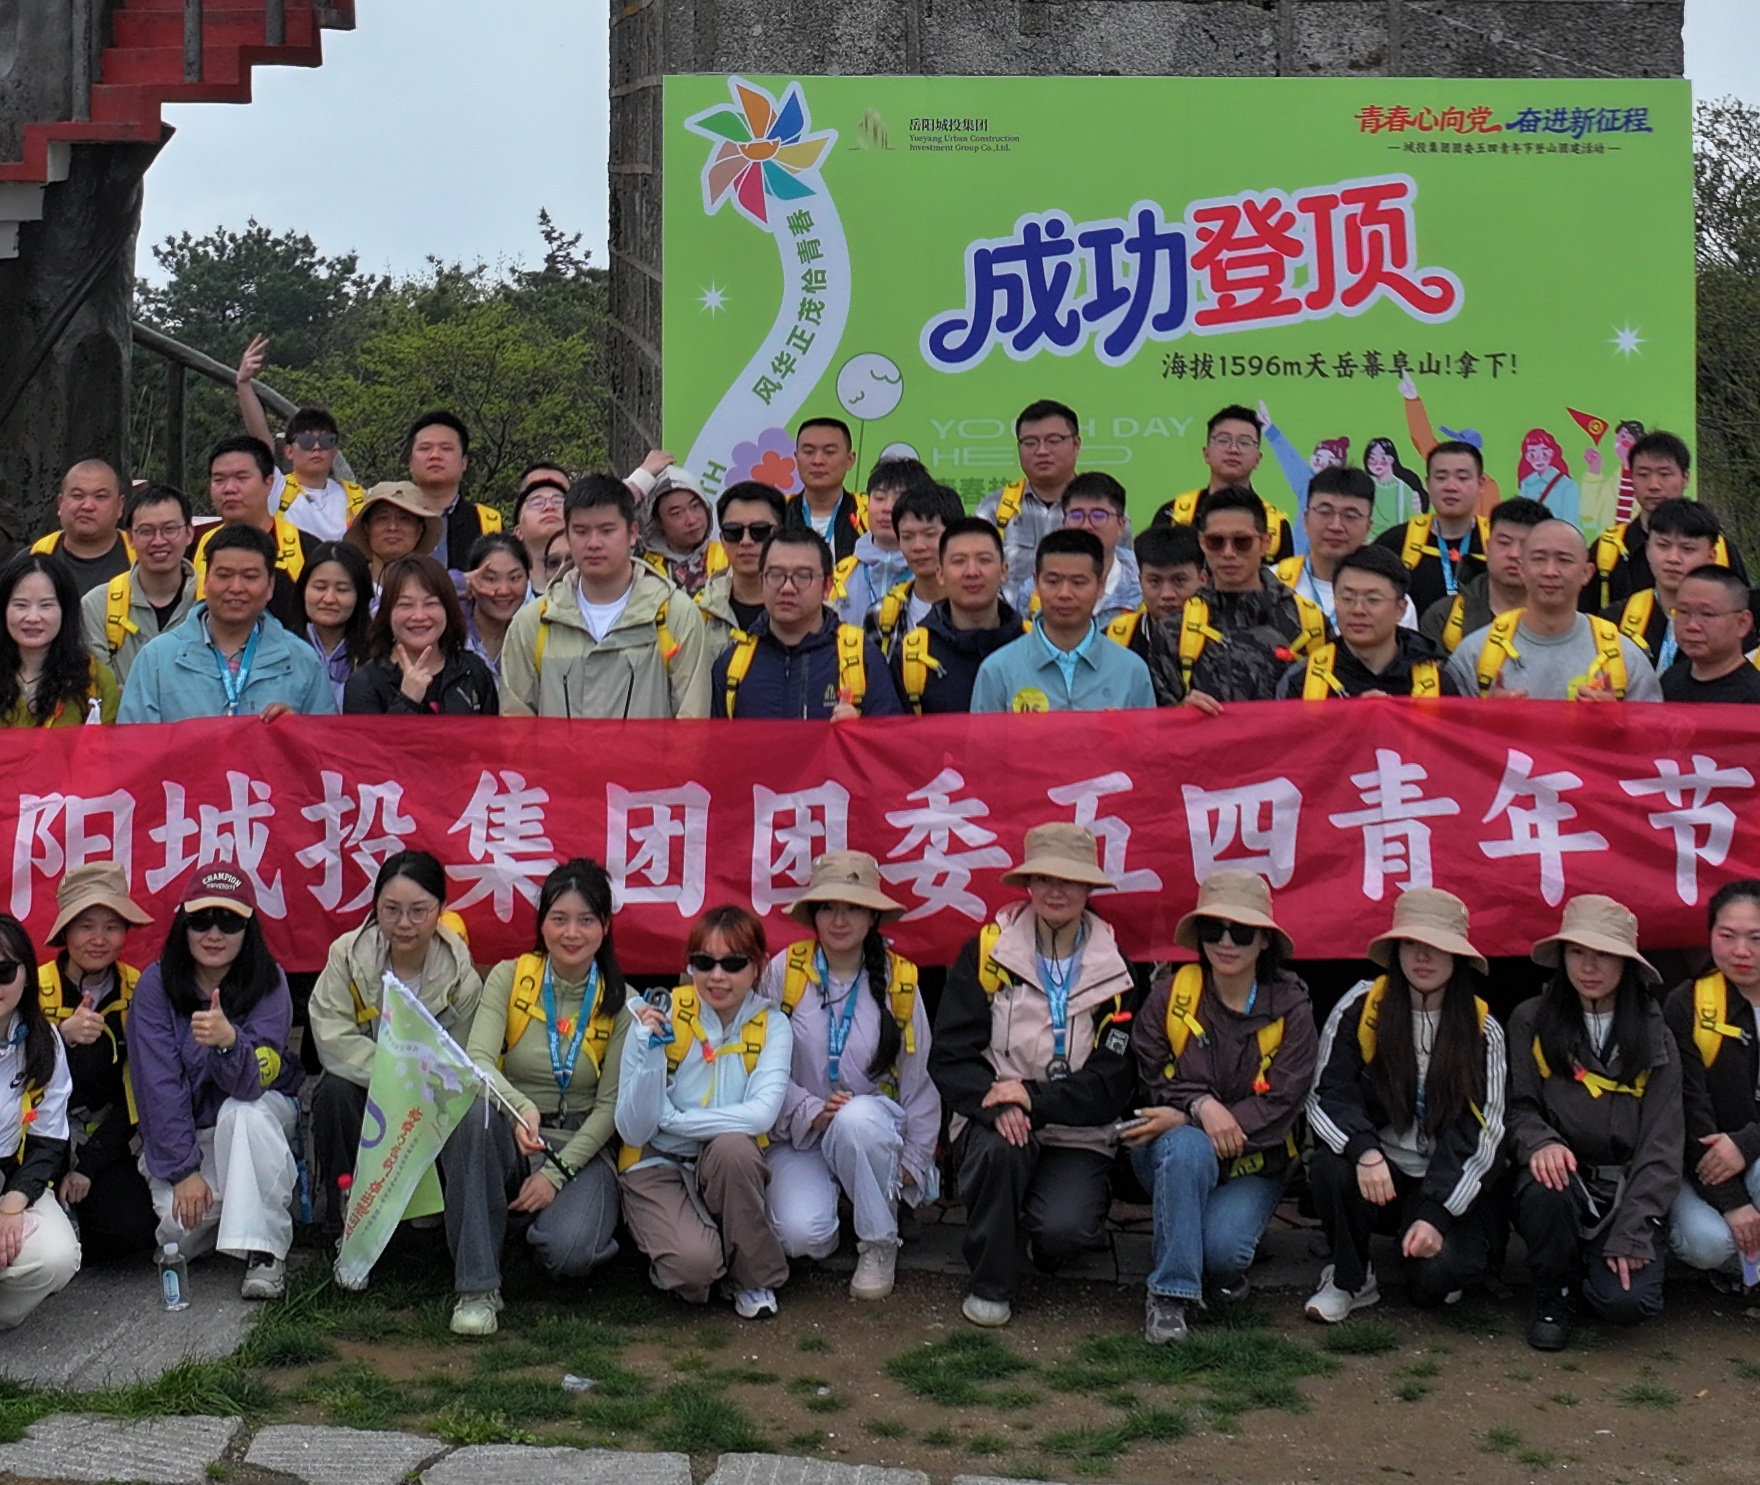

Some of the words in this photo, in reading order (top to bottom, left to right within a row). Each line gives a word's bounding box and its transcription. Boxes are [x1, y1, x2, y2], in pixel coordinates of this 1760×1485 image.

[909, 117, 988, 132] 岳阳城投集团
[1357, 105, 1503, 135] 青春心向党
[1505, 106, 1654, 140] 奋进新征程
[909, 135, 943, 144] Yueyang
[970, 134, 1020, 143] Construction
[929, 183, 1452, 363] 成功登顶
[752, 209, 828, 406] 风华正茂恰青春
[1112, 417, 1194, 437] DAY
[201, 871, 243, 889] CHAMPION
